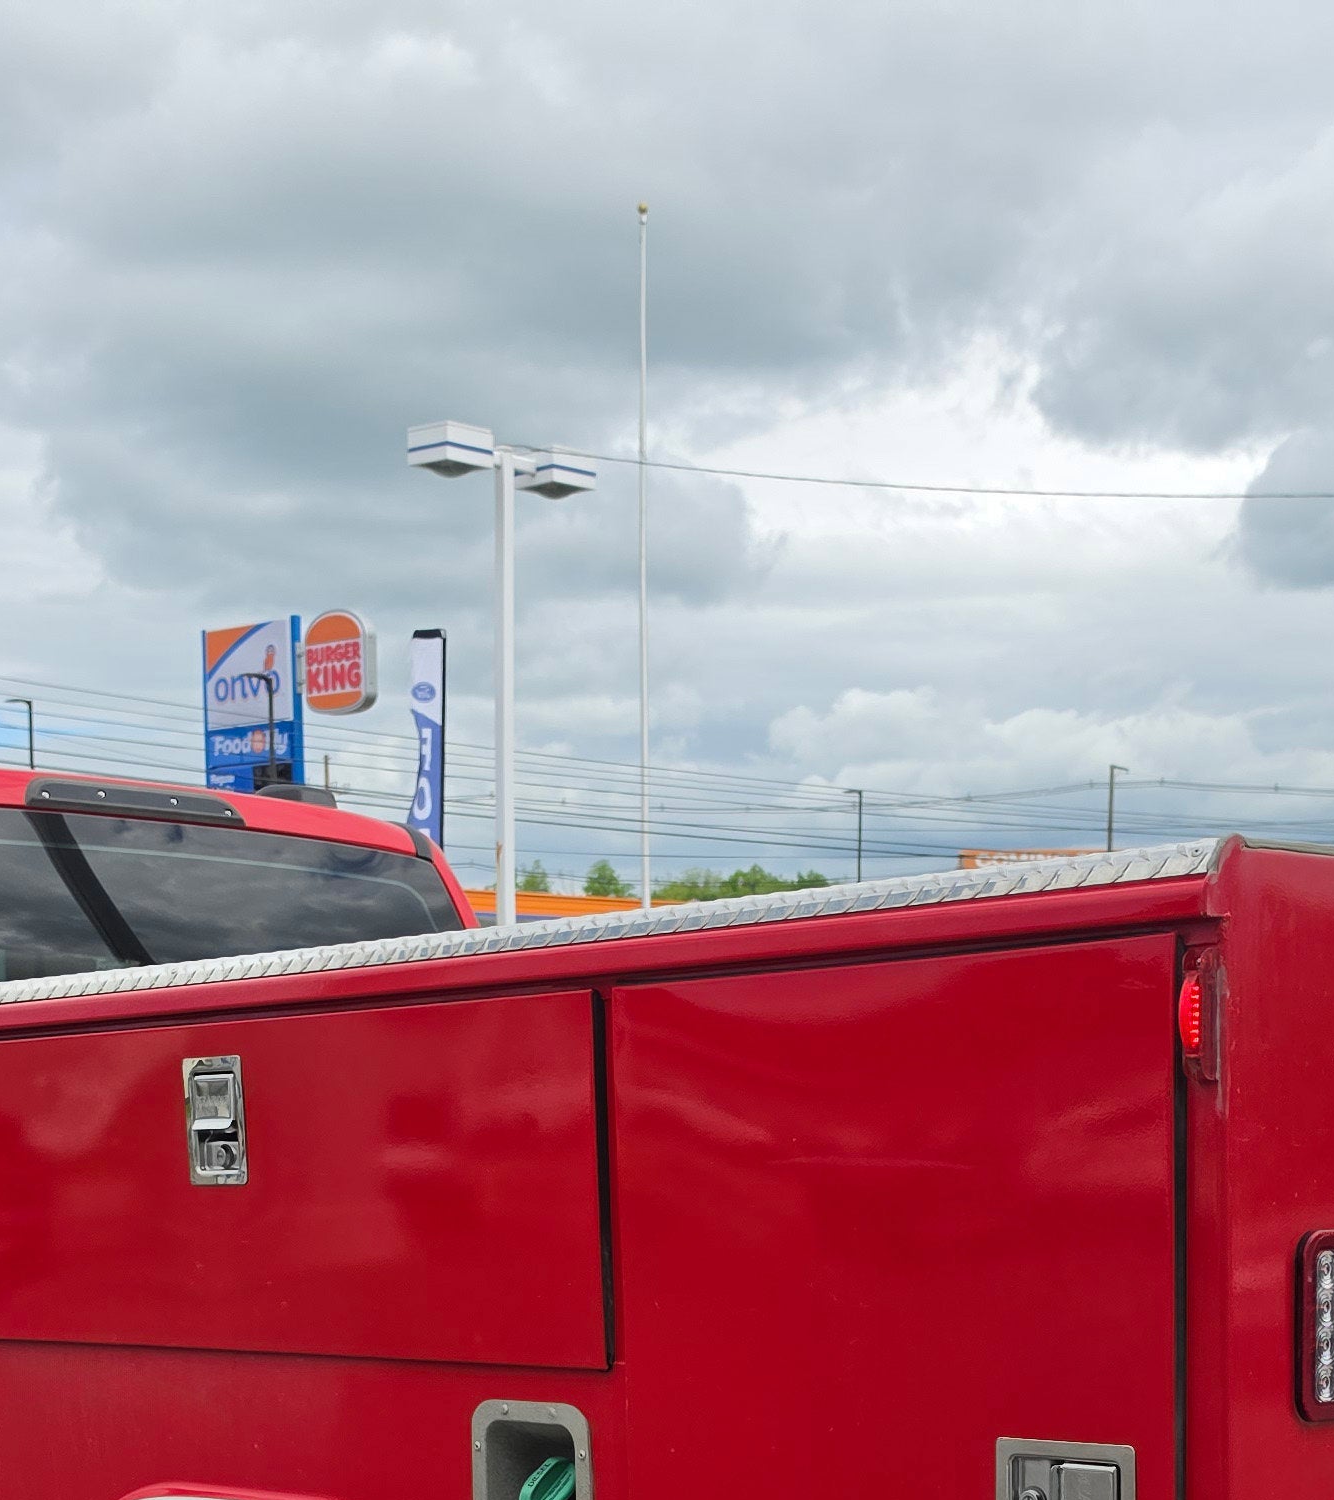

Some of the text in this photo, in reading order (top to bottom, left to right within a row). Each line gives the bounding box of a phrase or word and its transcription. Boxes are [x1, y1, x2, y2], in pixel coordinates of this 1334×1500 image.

[307, 641, 361, 667] BURGER
[307, 661, 362, 695] KING
[209, 731, 253, 757] Food
